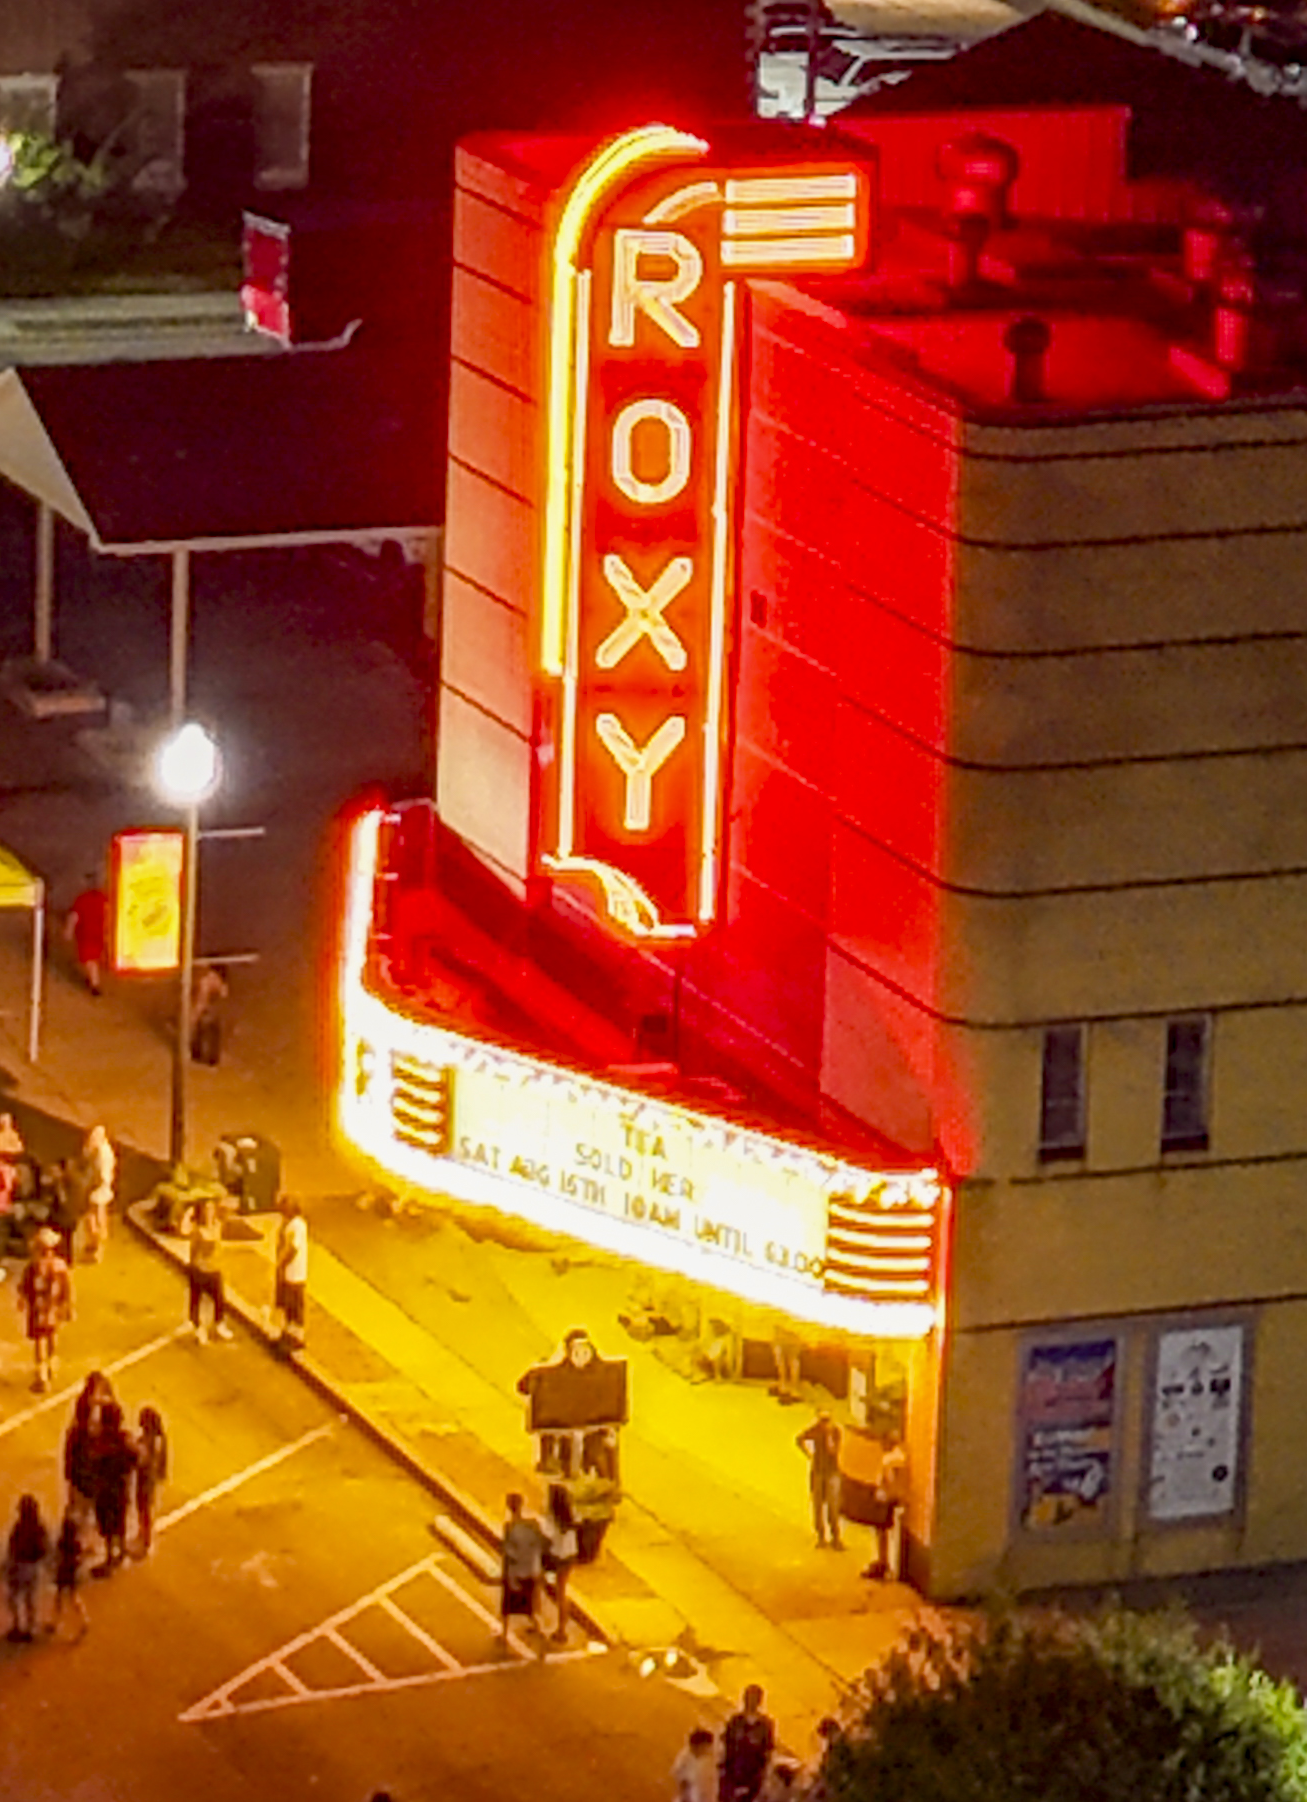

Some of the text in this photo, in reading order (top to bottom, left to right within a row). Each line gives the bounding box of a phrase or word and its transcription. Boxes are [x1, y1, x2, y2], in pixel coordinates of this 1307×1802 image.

[595, 227, 702, 832] ROXY
[460, 1136, 500, 1170] SAT
[575, 1143, 633, 1180] SOLD
